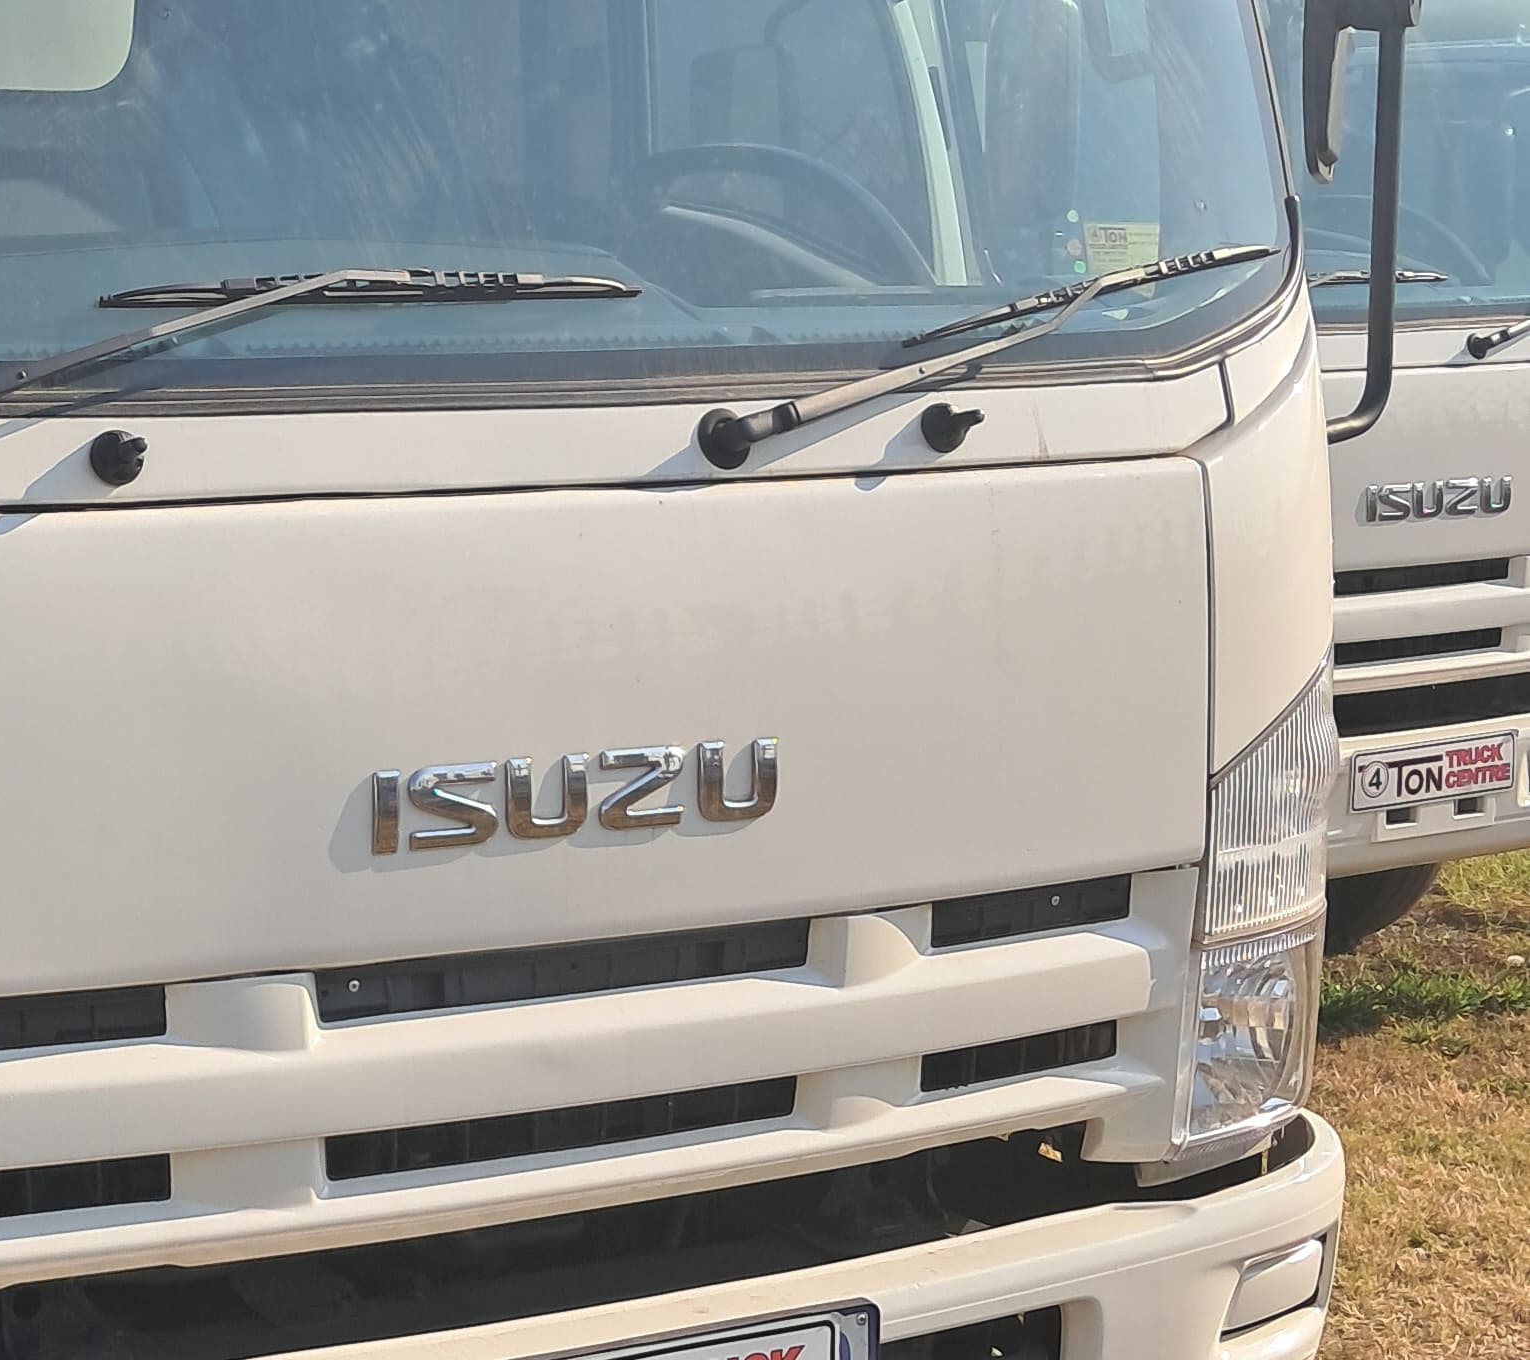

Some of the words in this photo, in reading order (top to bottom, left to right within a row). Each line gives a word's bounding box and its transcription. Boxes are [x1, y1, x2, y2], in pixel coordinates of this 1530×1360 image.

[1365, 474, 1514, 523] ISUZU
[1367, 767, 1383, 791] 4
[1386, 754, 1444, 798] TON
[1445, 742, 1504, 769] TRUCK
[1445, 762, 1511, 790] CENTRE
[370, 736, 780, 857] ISUZU
